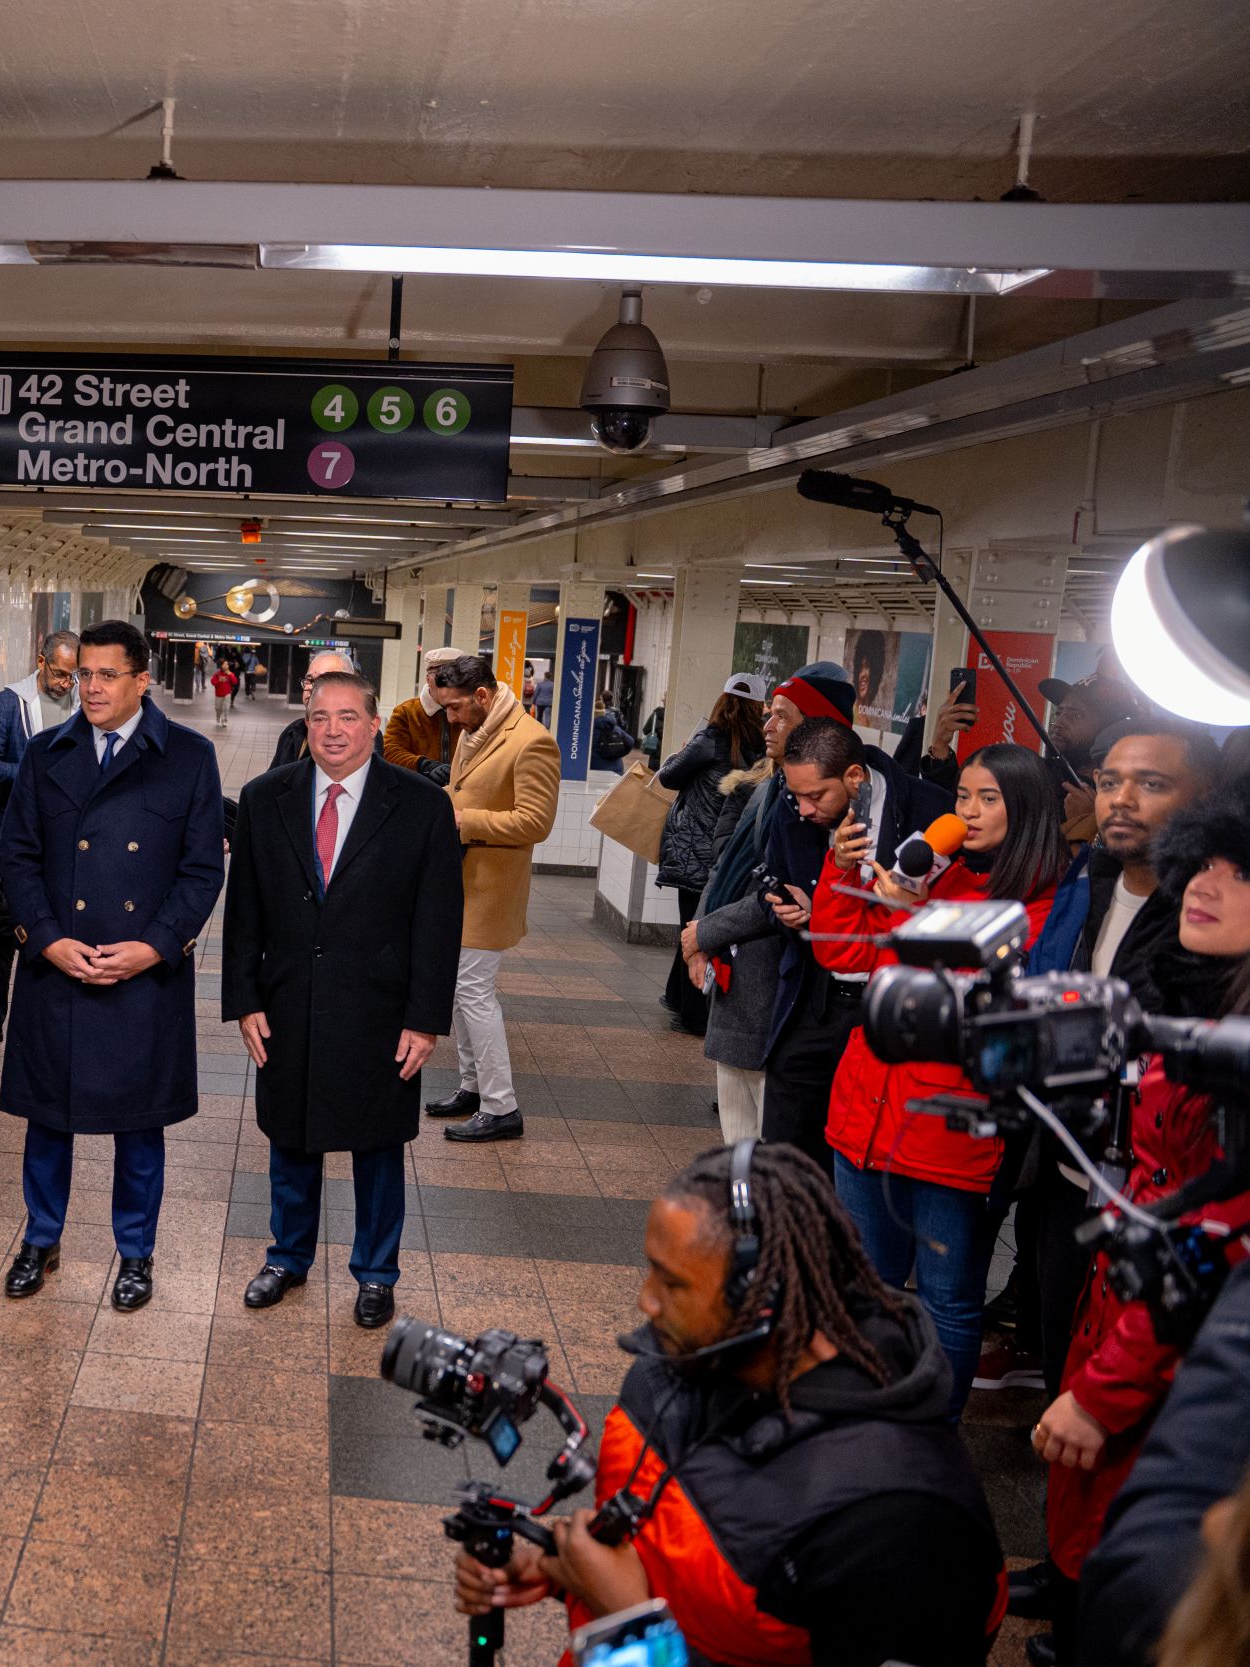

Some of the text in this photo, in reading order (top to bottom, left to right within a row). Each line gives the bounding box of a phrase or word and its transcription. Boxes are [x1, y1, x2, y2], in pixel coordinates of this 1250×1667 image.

[18, 374, 190, 408] 42 Street
[324, 394, 457, 426] 4 5 6
[18, 411, 285, 450] Grand Central
[17, 449, 253, 487] Metro-North
[321, 452, 342, 480] 7
[576, 655, 585, 670] at
[581, 640, 591, 662] you
[571, 670, 584, 699] Smiles
[858, 704, 893, 720] DOMINICANA
[571, 699, 582, 760] DOMINICANA
